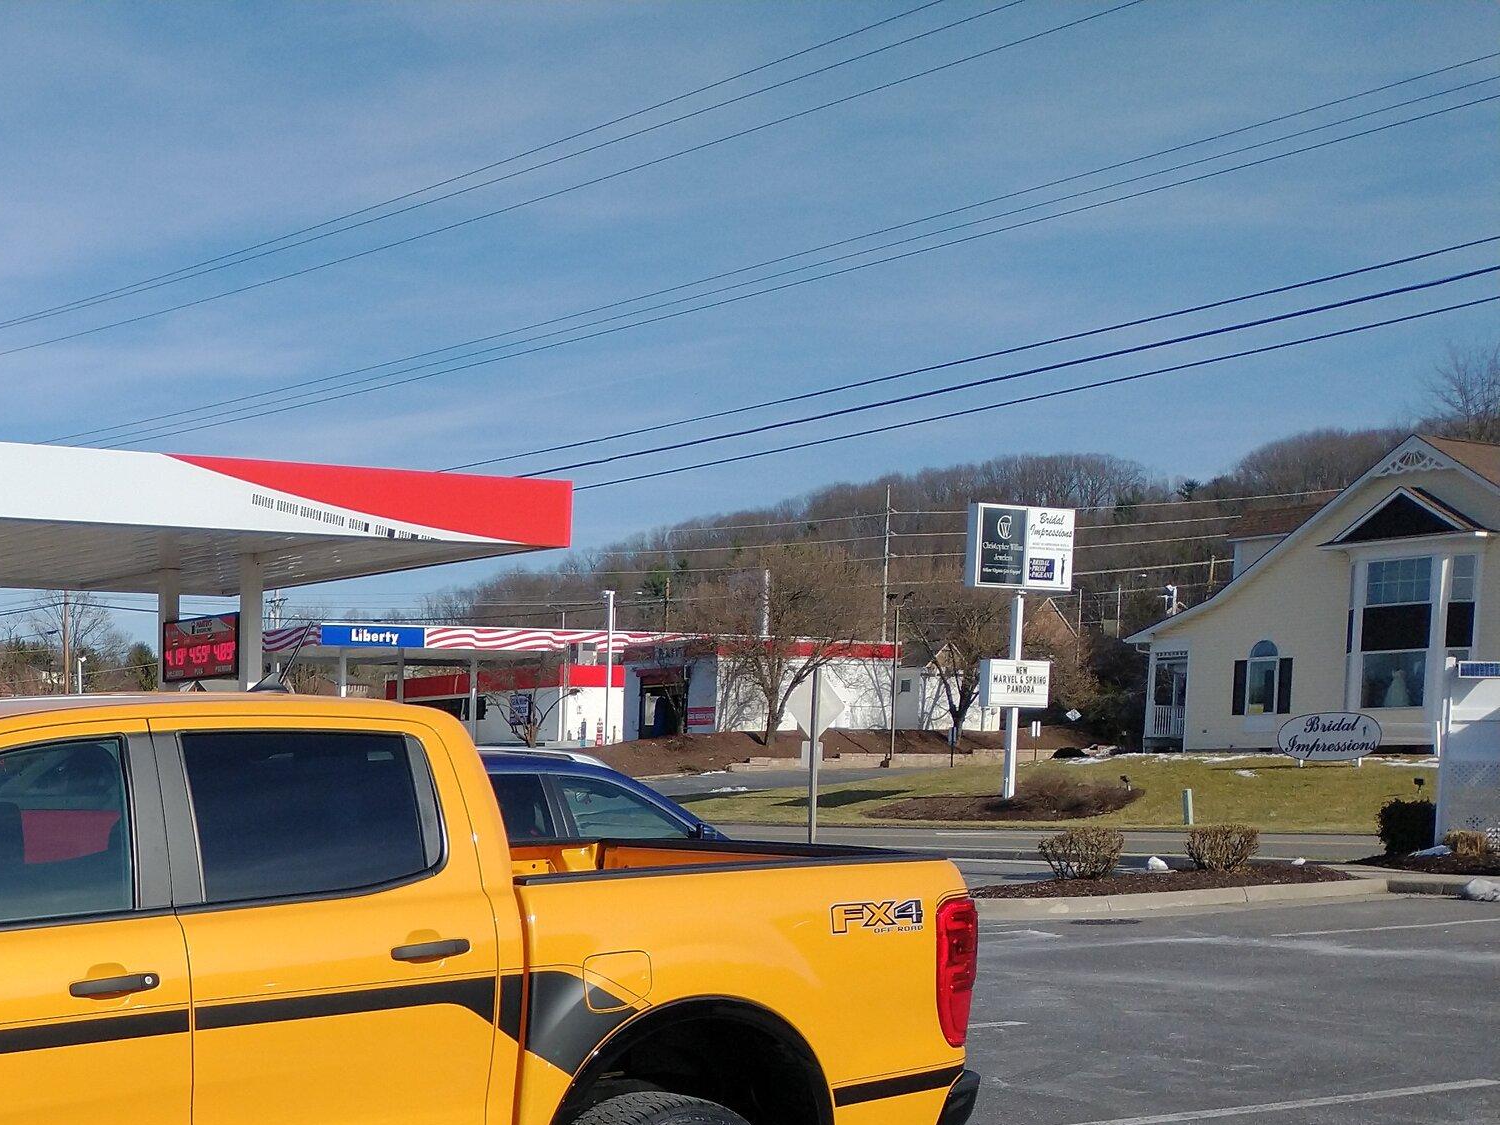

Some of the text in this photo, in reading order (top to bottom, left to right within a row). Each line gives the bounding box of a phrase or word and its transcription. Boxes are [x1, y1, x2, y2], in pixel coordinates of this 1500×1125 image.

[1040, 513, 1065, 525] Bridal
[1030, 524, 1072, 538] Impressions
[351, 628, 399, 645] Liberty
[1016, 666, 1028, 674] NEW
[993, 675, 1018, 684] MARVEL
[1025, 675, 1047, 684] SPRING
[1007, 685, 1035, 693] PANDORA
[1304, 716, 1361, 733] Bridal
[1285, 735, 1376, 758] Impressions
[830, 899, 923, 934] FX4
